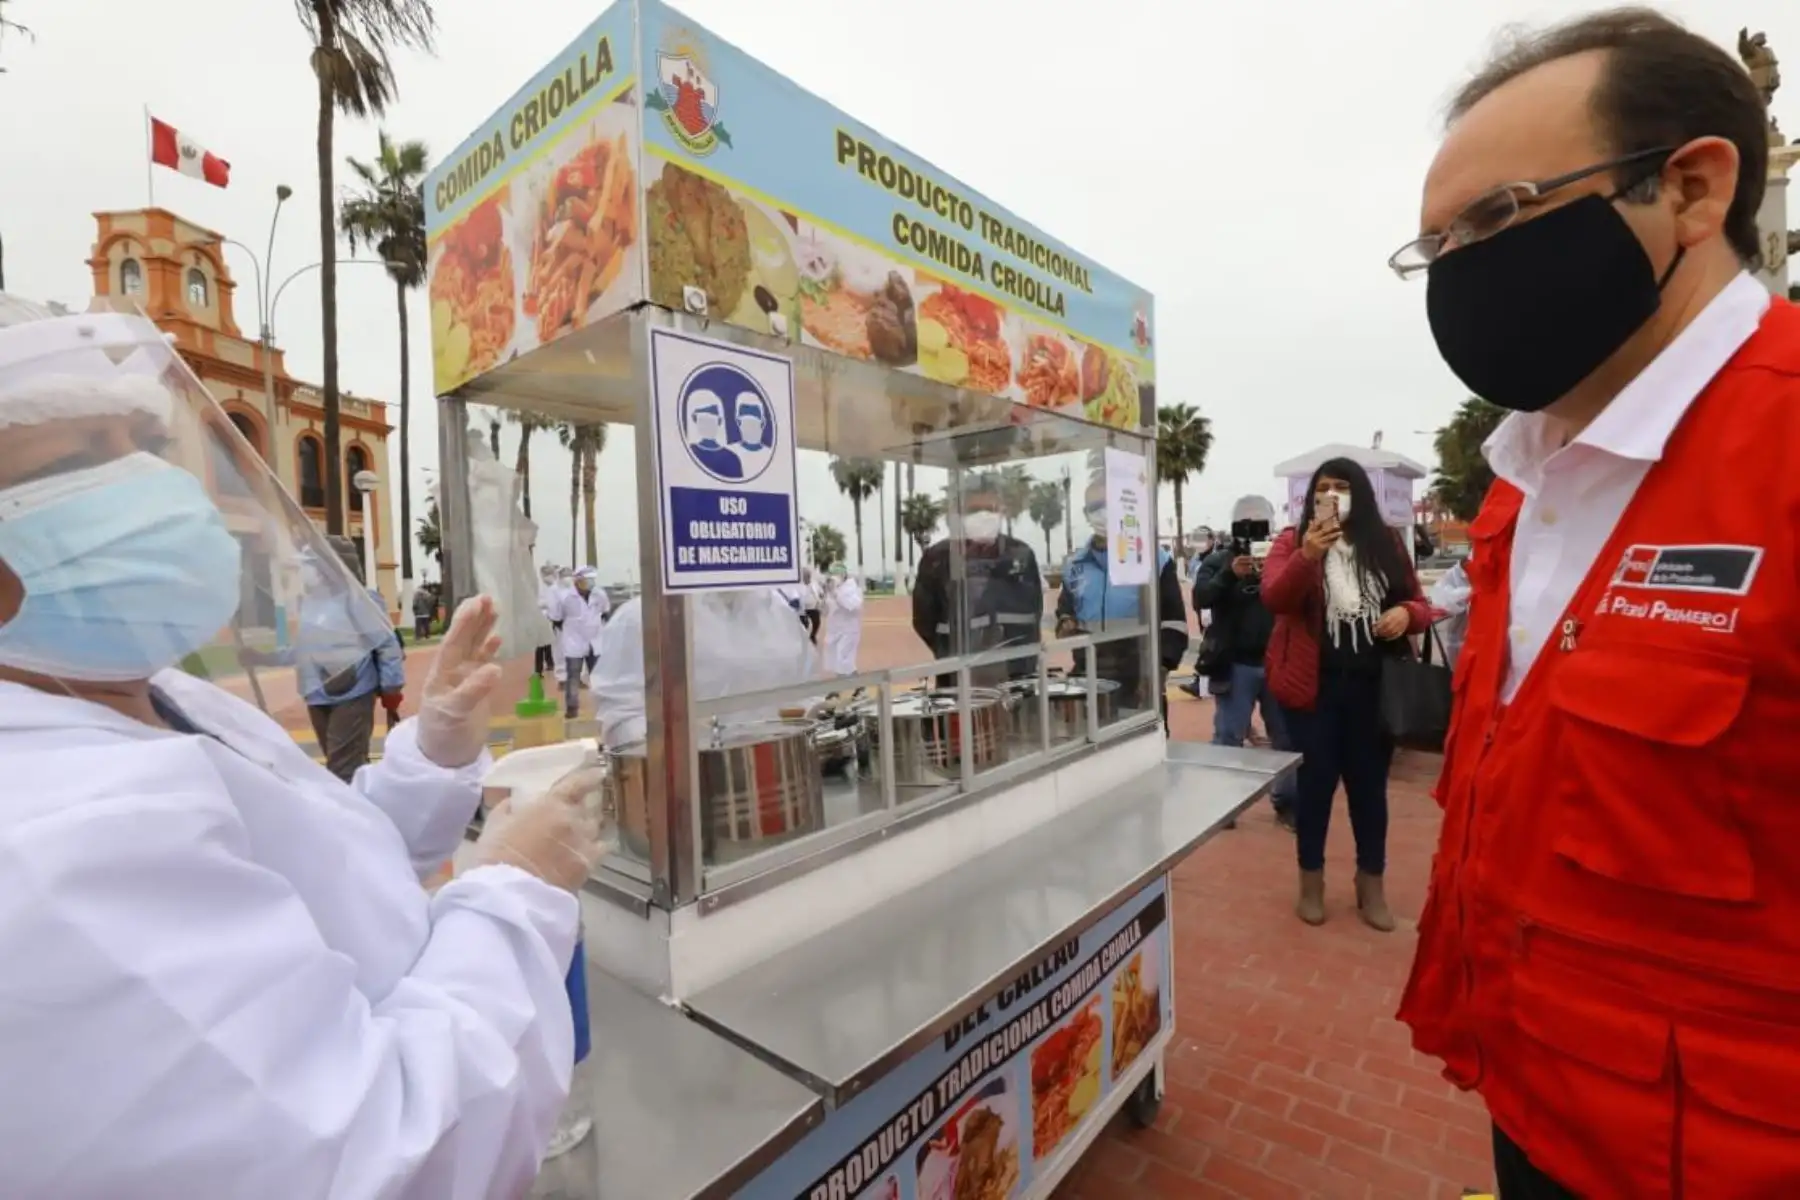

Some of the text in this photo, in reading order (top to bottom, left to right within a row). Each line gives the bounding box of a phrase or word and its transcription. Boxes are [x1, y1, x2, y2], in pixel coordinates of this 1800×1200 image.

[435, 36, 613, 213] COMIDA CRIOLLA
[836, 128, 1093, 294] PRODUCTO TRADICIONAL
[892, 212, 1065, 317] COMIDA CRIOLLA
[678, 546, 788, 565] DE MASCARILLAS
[689, 520, 777, 540] OBLIGATORIO
[719, 496, 747, 515] USO
[936, 1001, 1050, 1109] TRADICIONAL
[1051, 955, 1101, 1018] COMIDA
[1101, 918, 1142, 972] CRIOLLA
